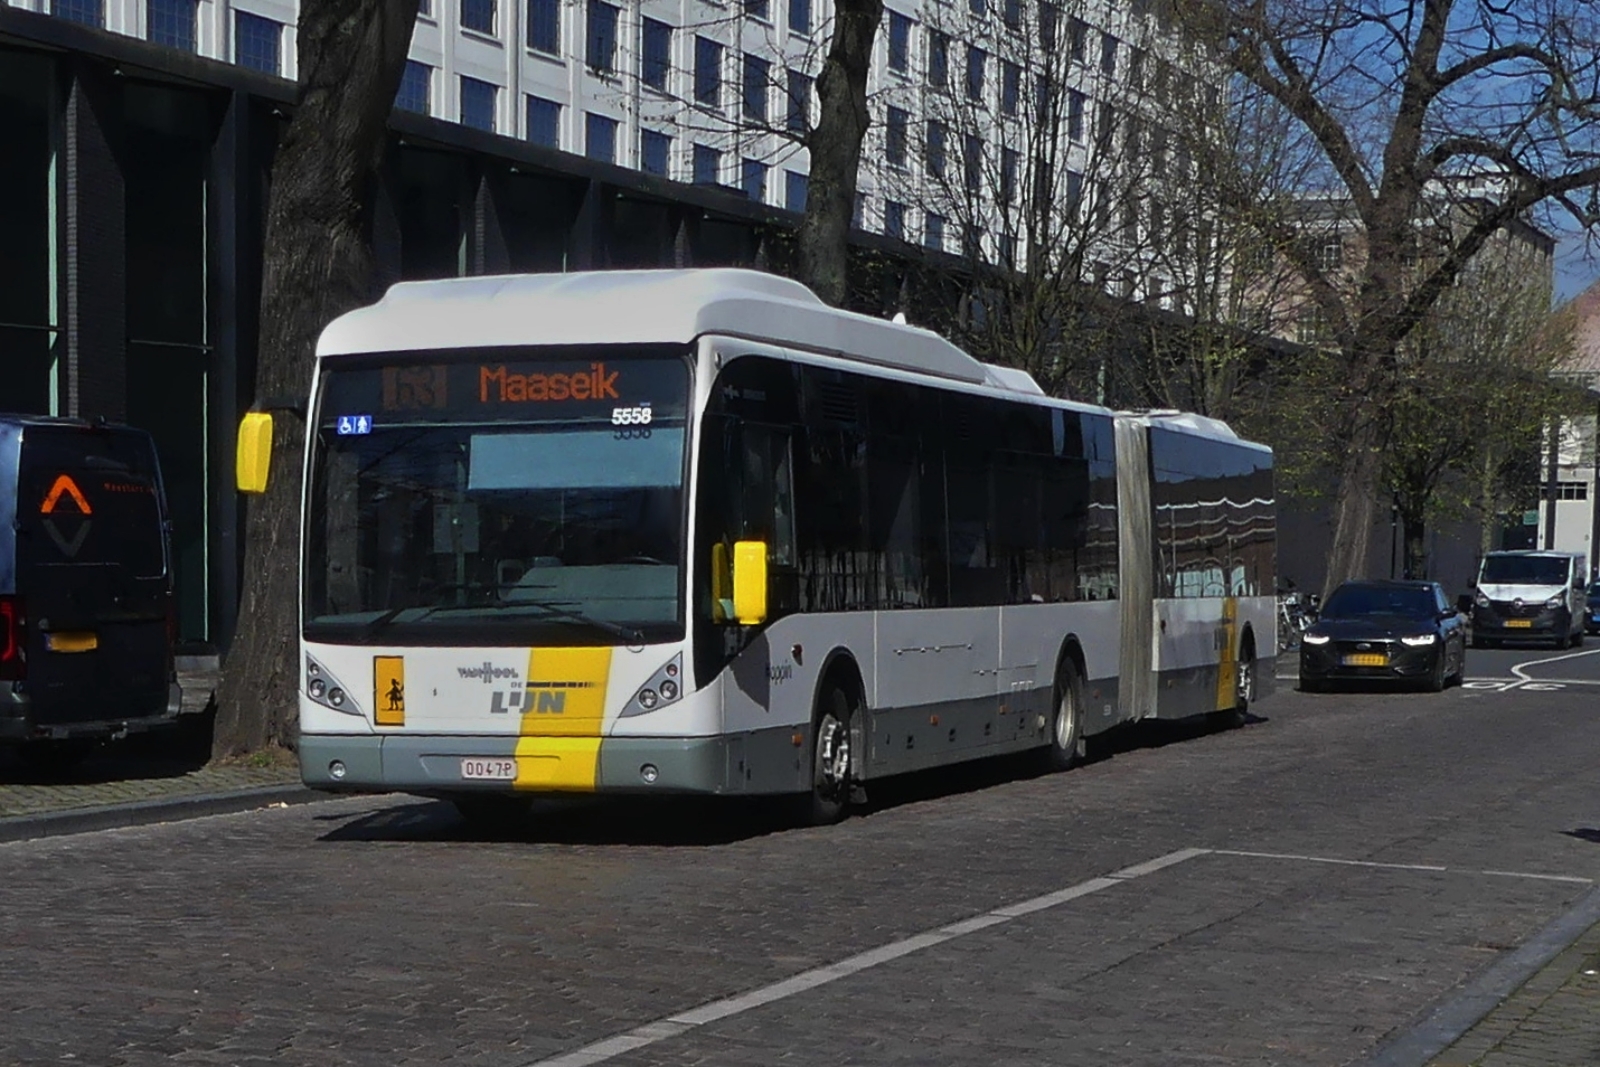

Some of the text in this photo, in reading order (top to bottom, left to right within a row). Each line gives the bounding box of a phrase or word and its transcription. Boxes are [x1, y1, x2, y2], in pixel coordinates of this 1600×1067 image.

[479, 362, 619, 402] Maaseik
[611, 407, 652, 425] 5558
[490, 691, 567, 714] LIJN
